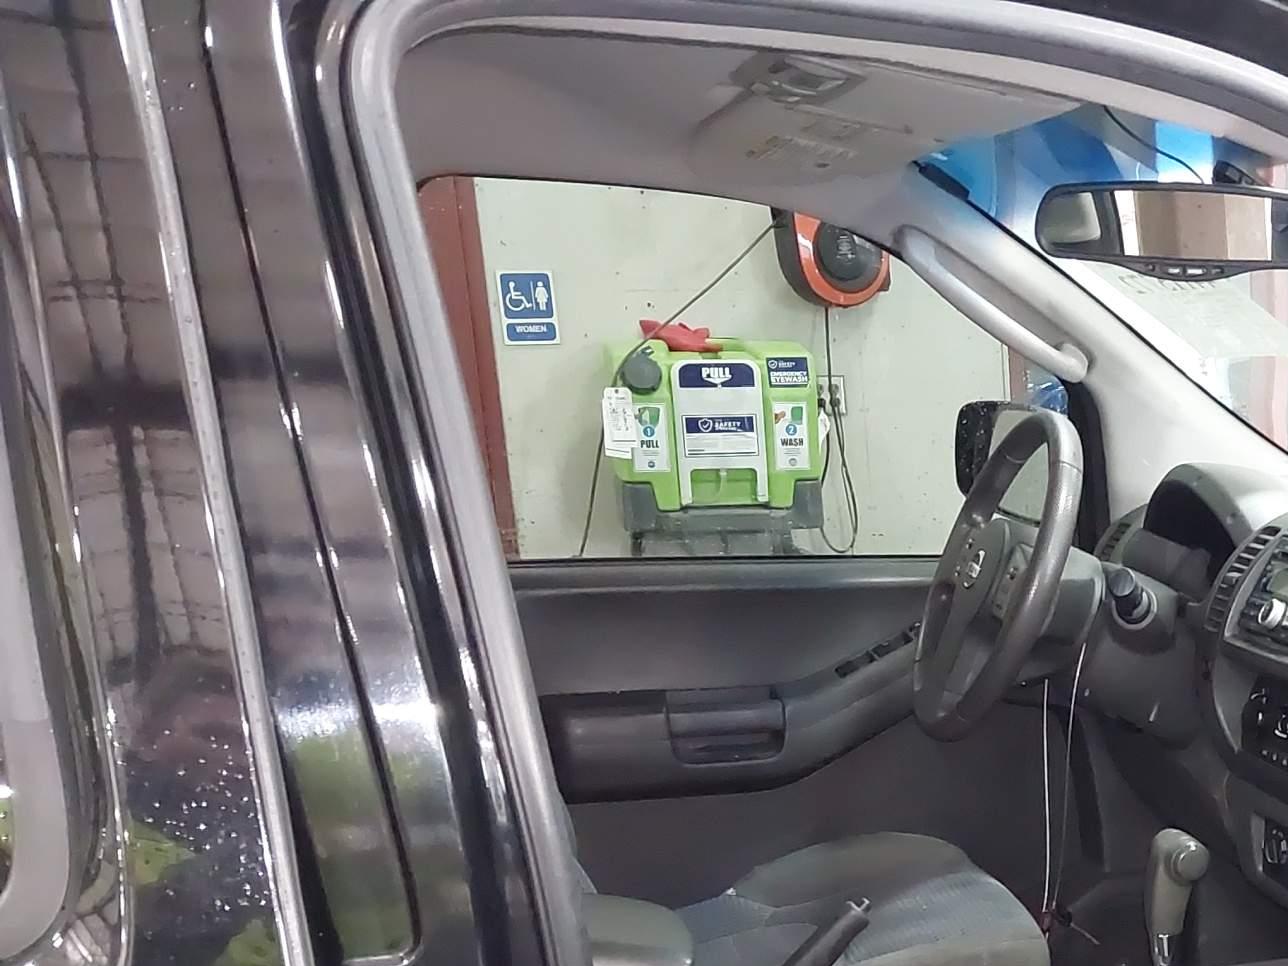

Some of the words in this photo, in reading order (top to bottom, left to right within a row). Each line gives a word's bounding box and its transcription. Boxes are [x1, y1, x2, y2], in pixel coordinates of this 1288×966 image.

[515, 324, 547, 333] WOMEN
[701, 367, 732, 378] PULL
[788, 425, 795, 434] 2
[640, 440, 660, 448] PULL
[780, 438, 803, 446] WASH
